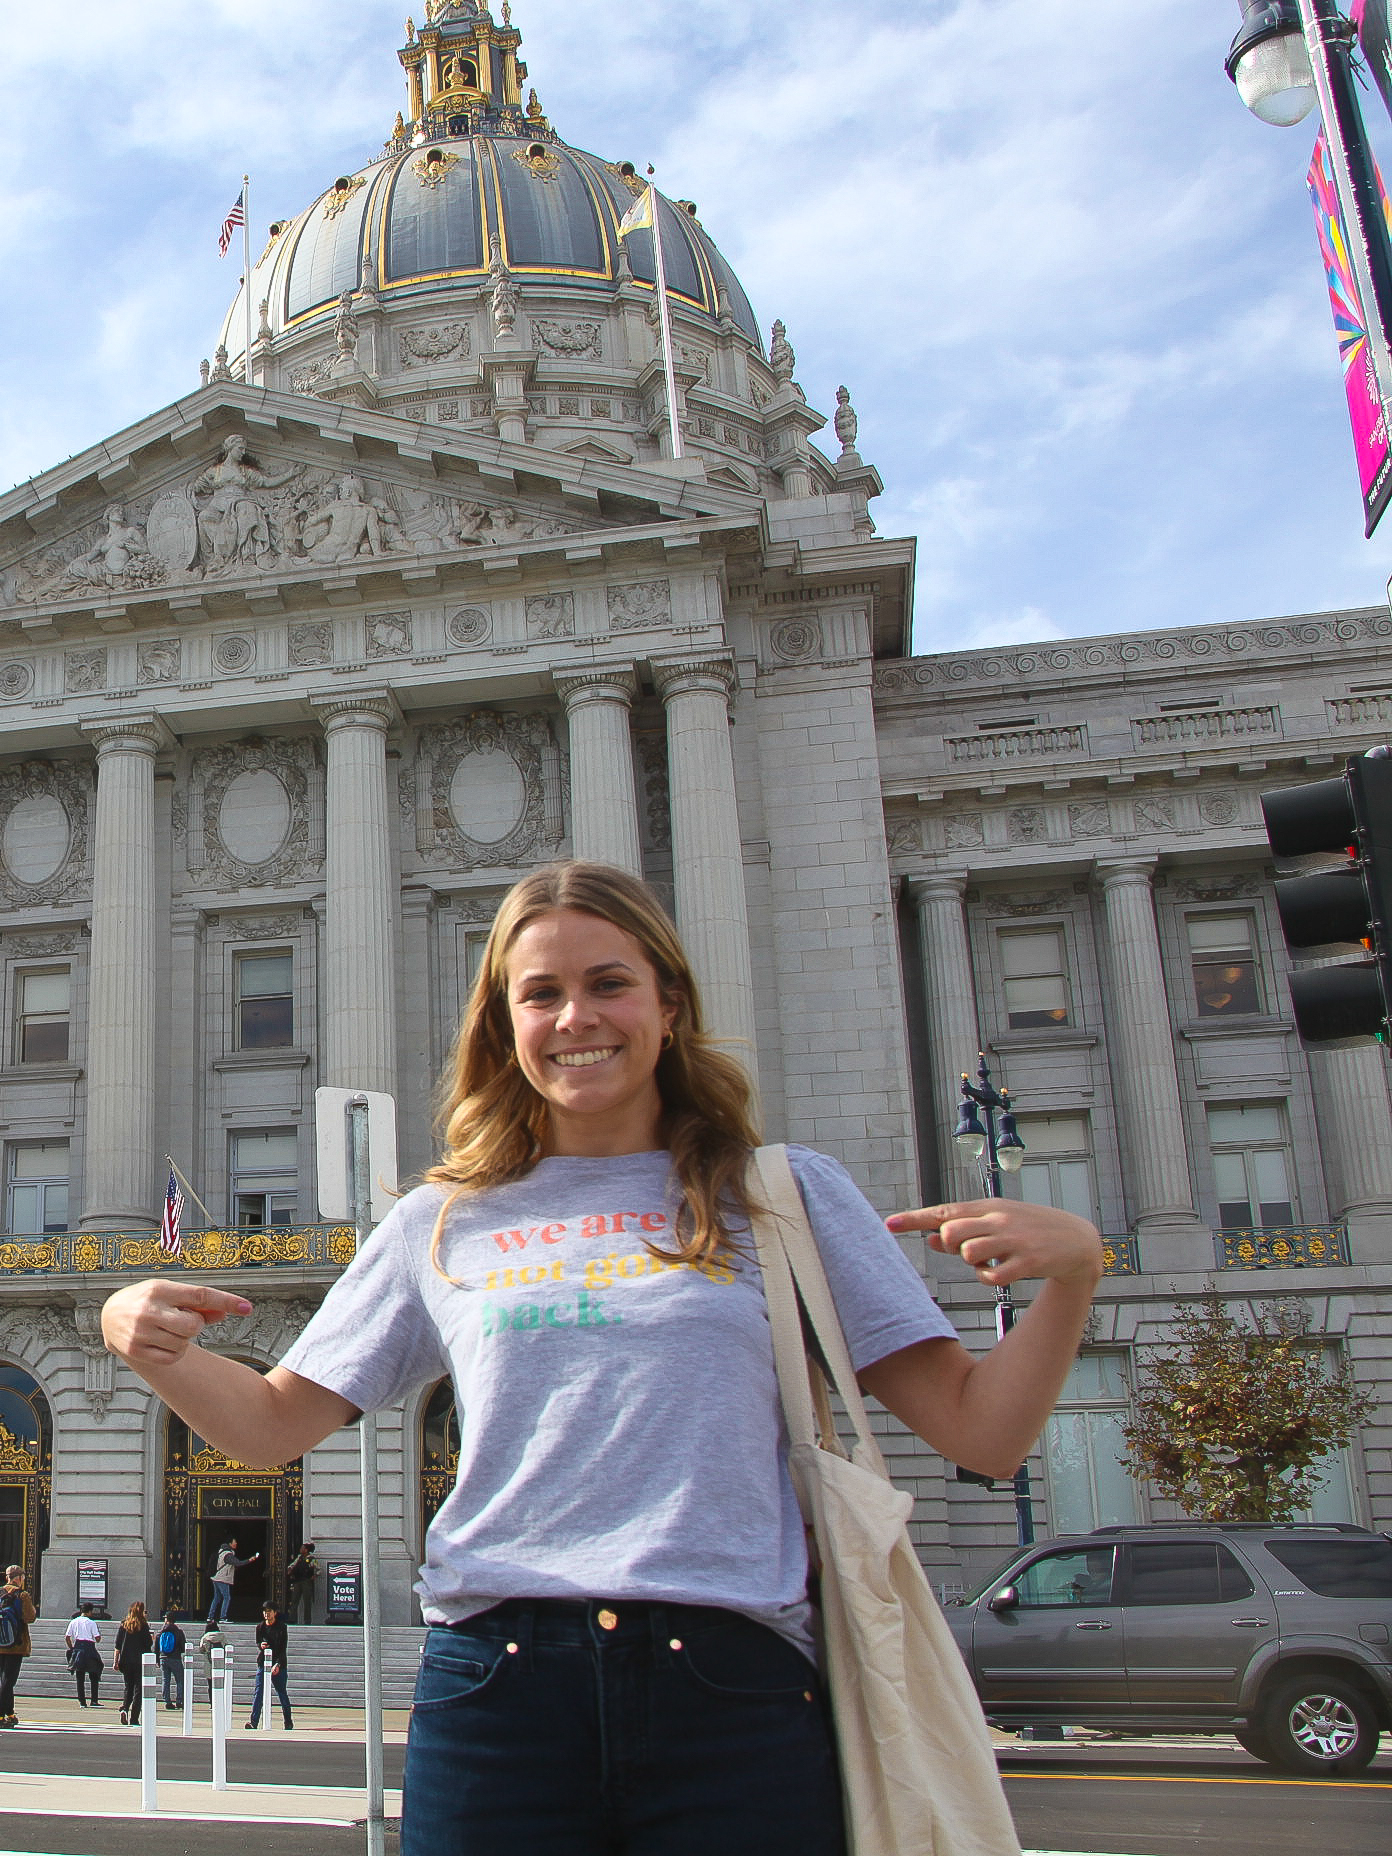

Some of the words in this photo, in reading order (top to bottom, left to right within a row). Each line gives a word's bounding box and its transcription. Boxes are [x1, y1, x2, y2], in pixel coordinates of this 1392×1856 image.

[490, 1221, 568, 1253] we
[579, 1211, 668, 1239] are
[483, 1260, 570, 1290] not
[482, 1291, 623, 1336] back.
[212, 1498, 235, 1508] CITY
[237, 1498, 259, 1508] HALL
[332, 1585, 355, 1594] Vote
[332, 1593, 355, 1602] Here!
